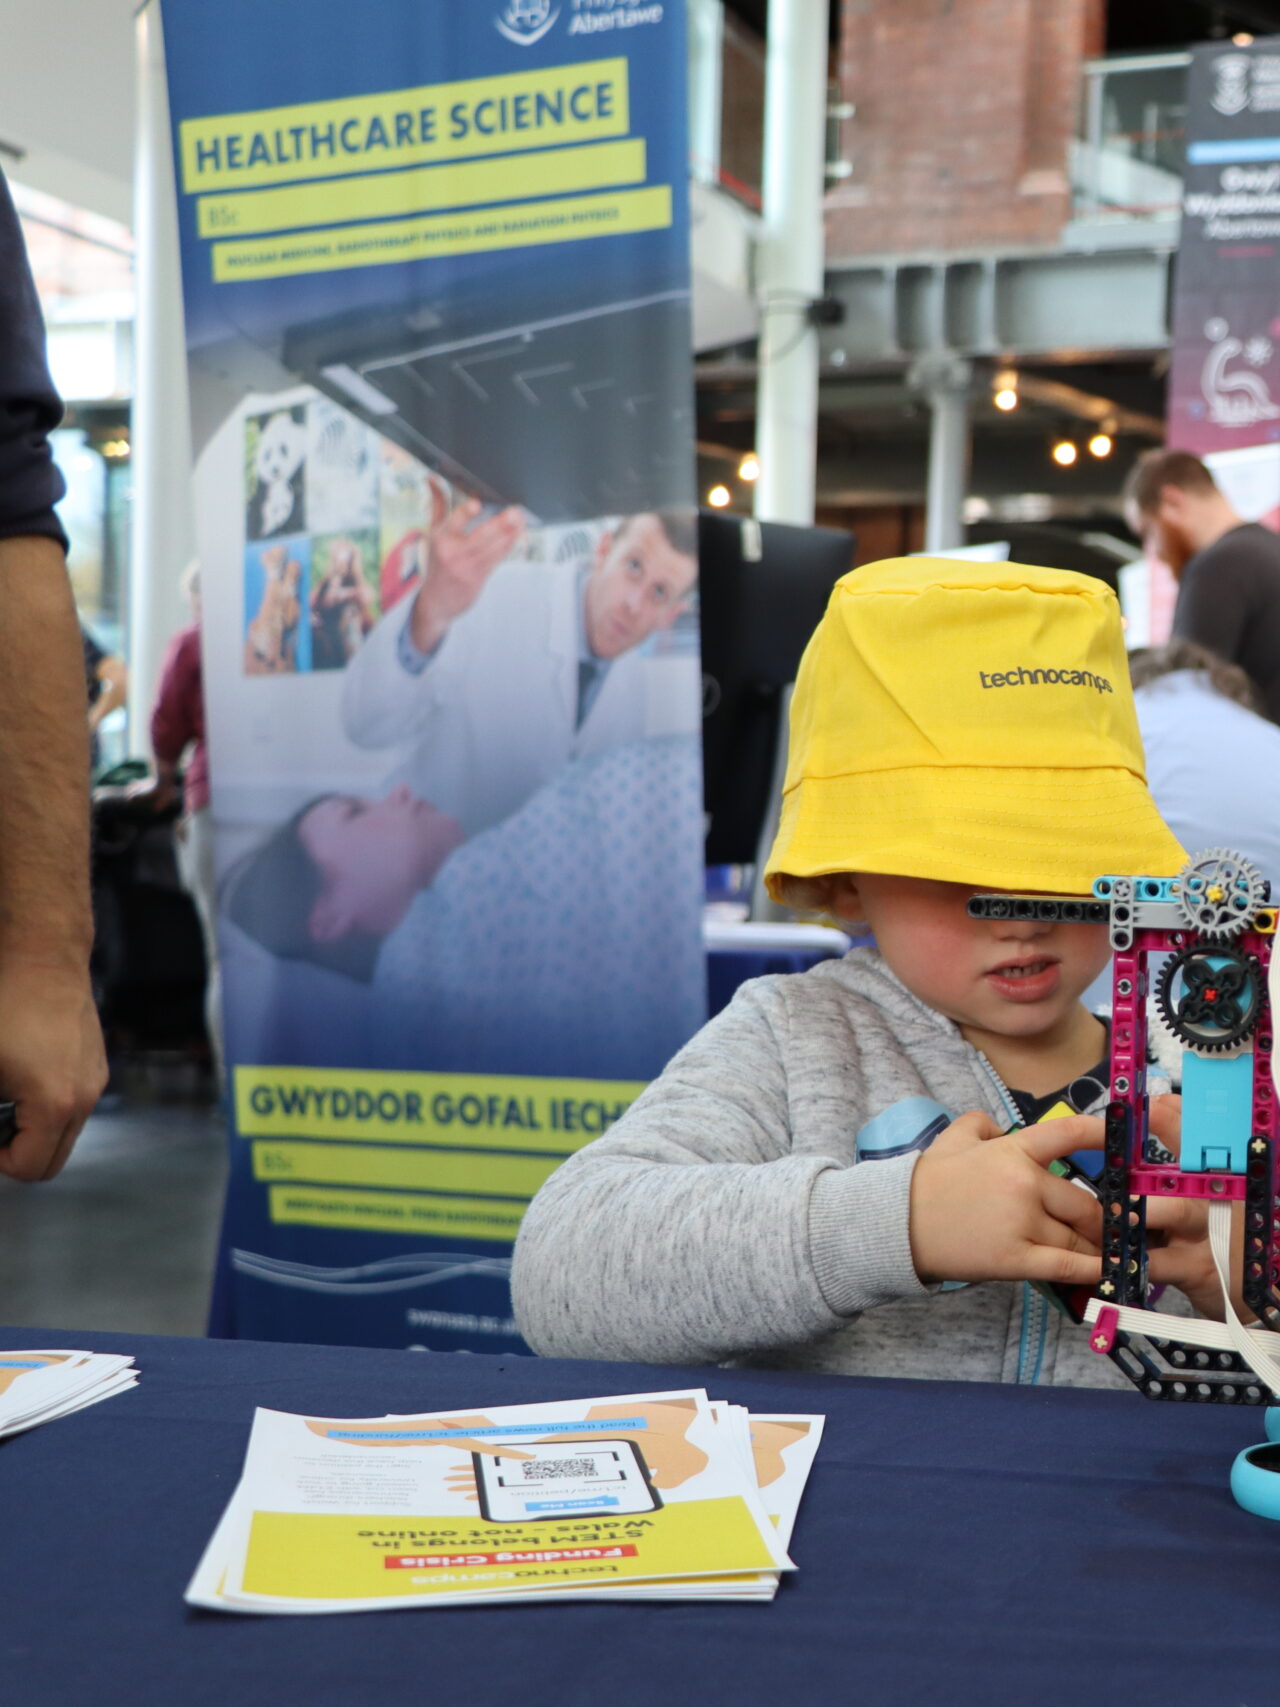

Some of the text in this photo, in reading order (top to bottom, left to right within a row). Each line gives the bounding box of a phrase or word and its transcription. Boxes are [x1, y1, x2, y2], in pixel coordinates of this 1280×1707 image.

[568, 4, 664, 36] Abertawe
[196, 81, 615, 174] HEALTHCARE SCIENCE
[207, 204, 240, 228] BSc
[979, 666, 1114, 694] technocamps
[250, 1085, 632, 1133] GWYDDOR GOFAL IECH
[358, 1531, 459, 1540] online
[469, 1530, 524, 1538] not
[557, 1520, 655, 1533] Wales
[372, 1529, 644, 1549] STEM belongs in
[399, 1548, 623, 1568] Funding Crisis
[409, 1565, 619, 1585] technocamps
